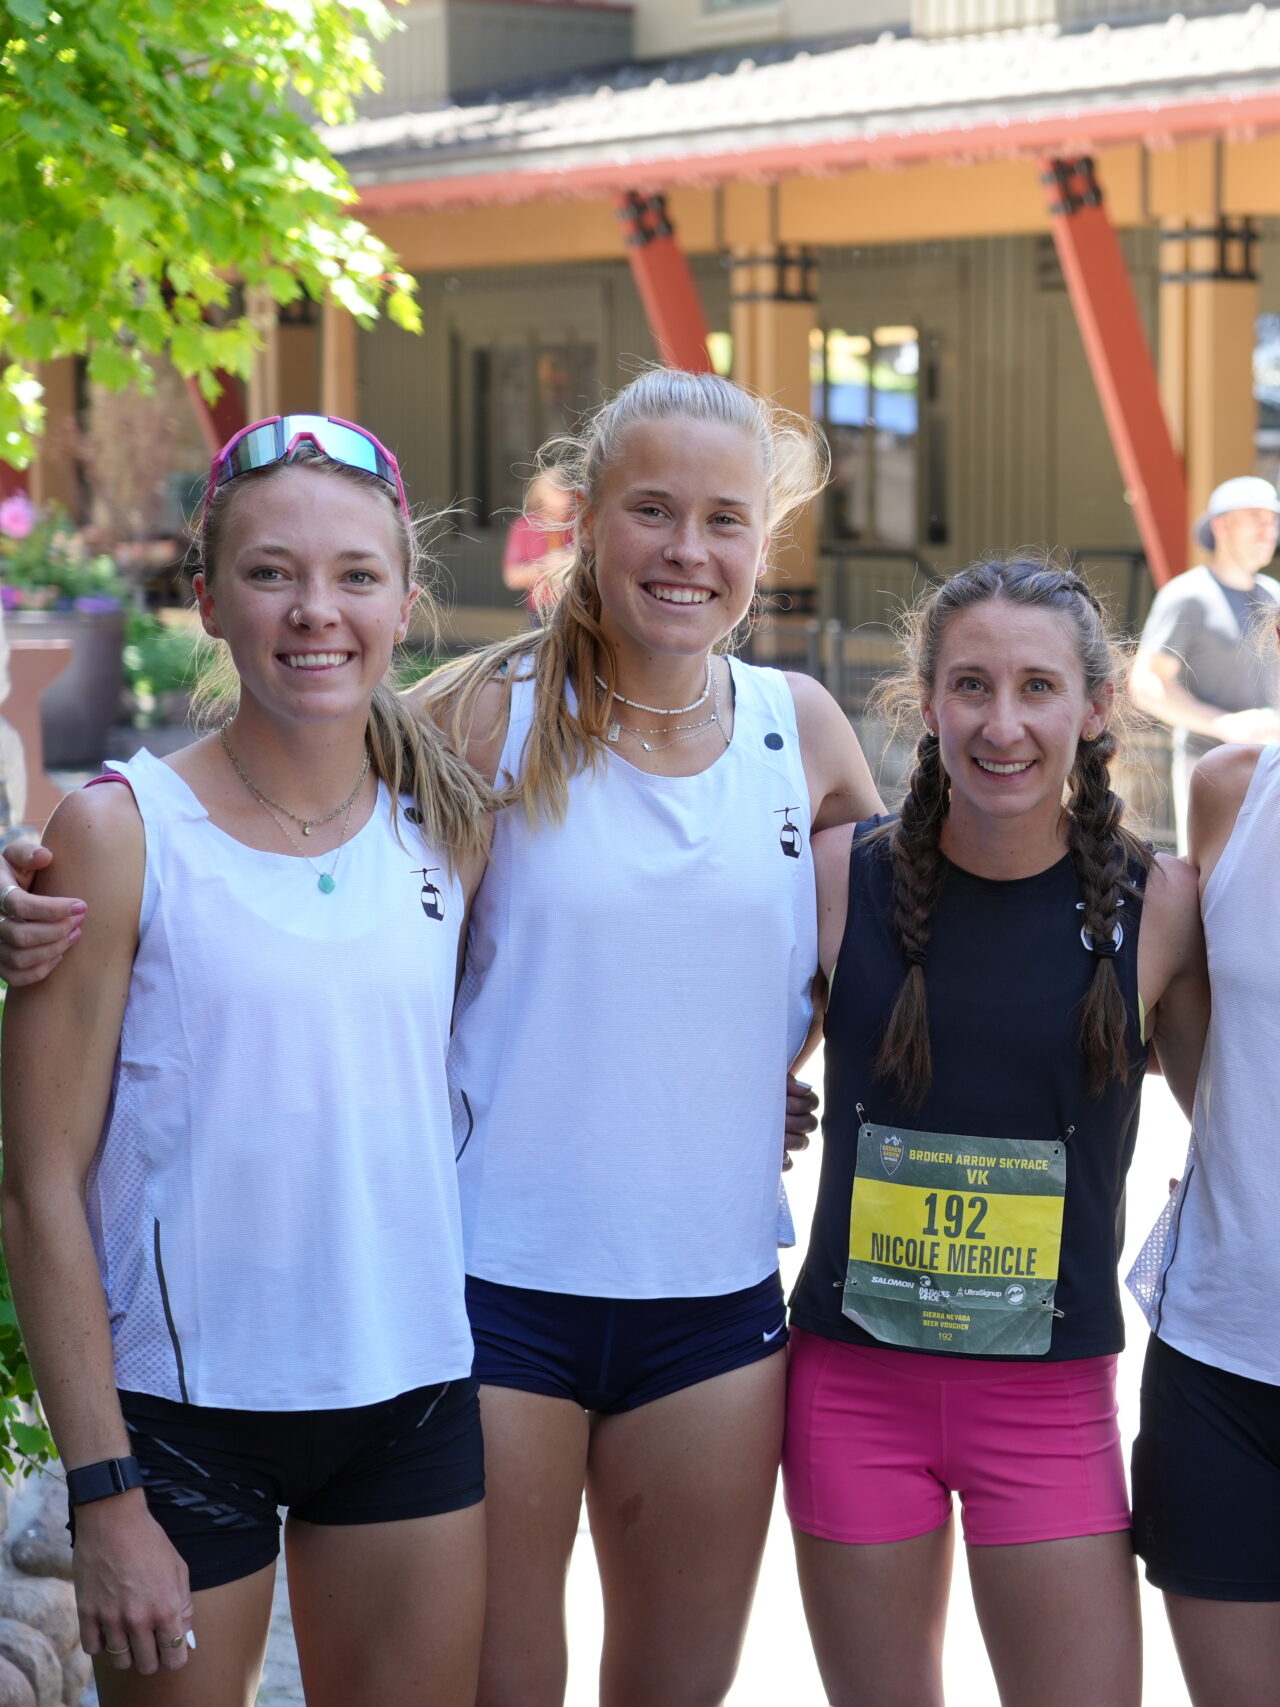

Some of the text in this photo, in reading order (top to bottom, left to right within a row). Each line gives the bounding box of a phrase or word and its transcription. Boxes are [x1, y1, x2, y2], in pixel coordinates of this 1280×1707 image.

[909, 1149, 953, 1163] BROKEN
[955, 1154, 997, 1167] ARROW
[999, 1157, 1049, 1171] SKYRACE
[966, 1168, 989, 1186] VK
[922, 1192, 988, 1240] 192
[870, 1232, 1038, 1276] NICOLE MERICLE
[871, 1276, 915, 1289] SALOMON
[964, 1288, 1002, 1298] UltraSignup
[923, 1310, 971, 1322] SIERRA NEVADA
[940, 1321, 969, 1331] VOUCHER
[937, 1332, 953, 1341] 192
